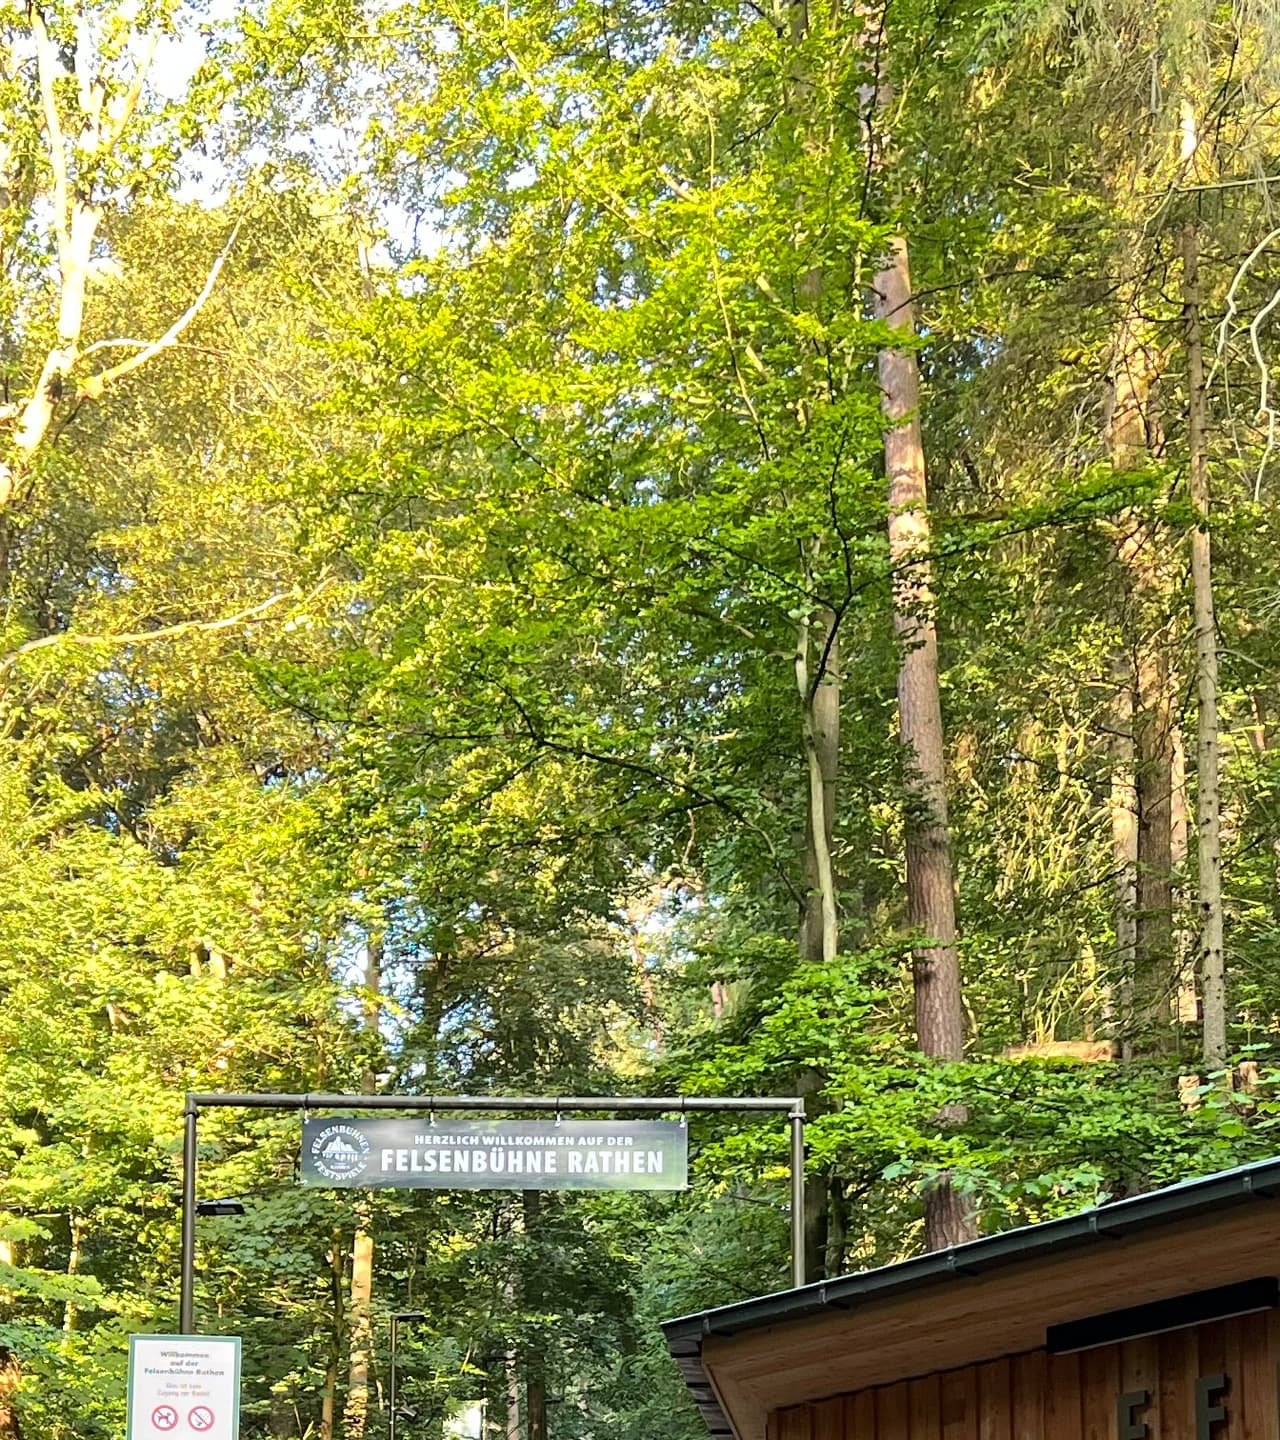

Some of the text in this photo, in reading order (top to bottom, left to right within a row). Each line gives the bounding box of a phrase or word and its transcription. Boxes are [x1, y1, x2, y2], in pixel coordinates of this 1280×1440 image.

[415, 1135, 634, 1147] HERZLICH WILLKOMMEN AUF DER
[381, 1147, 663, 1173] FELSENBÜHNE RATHEN
